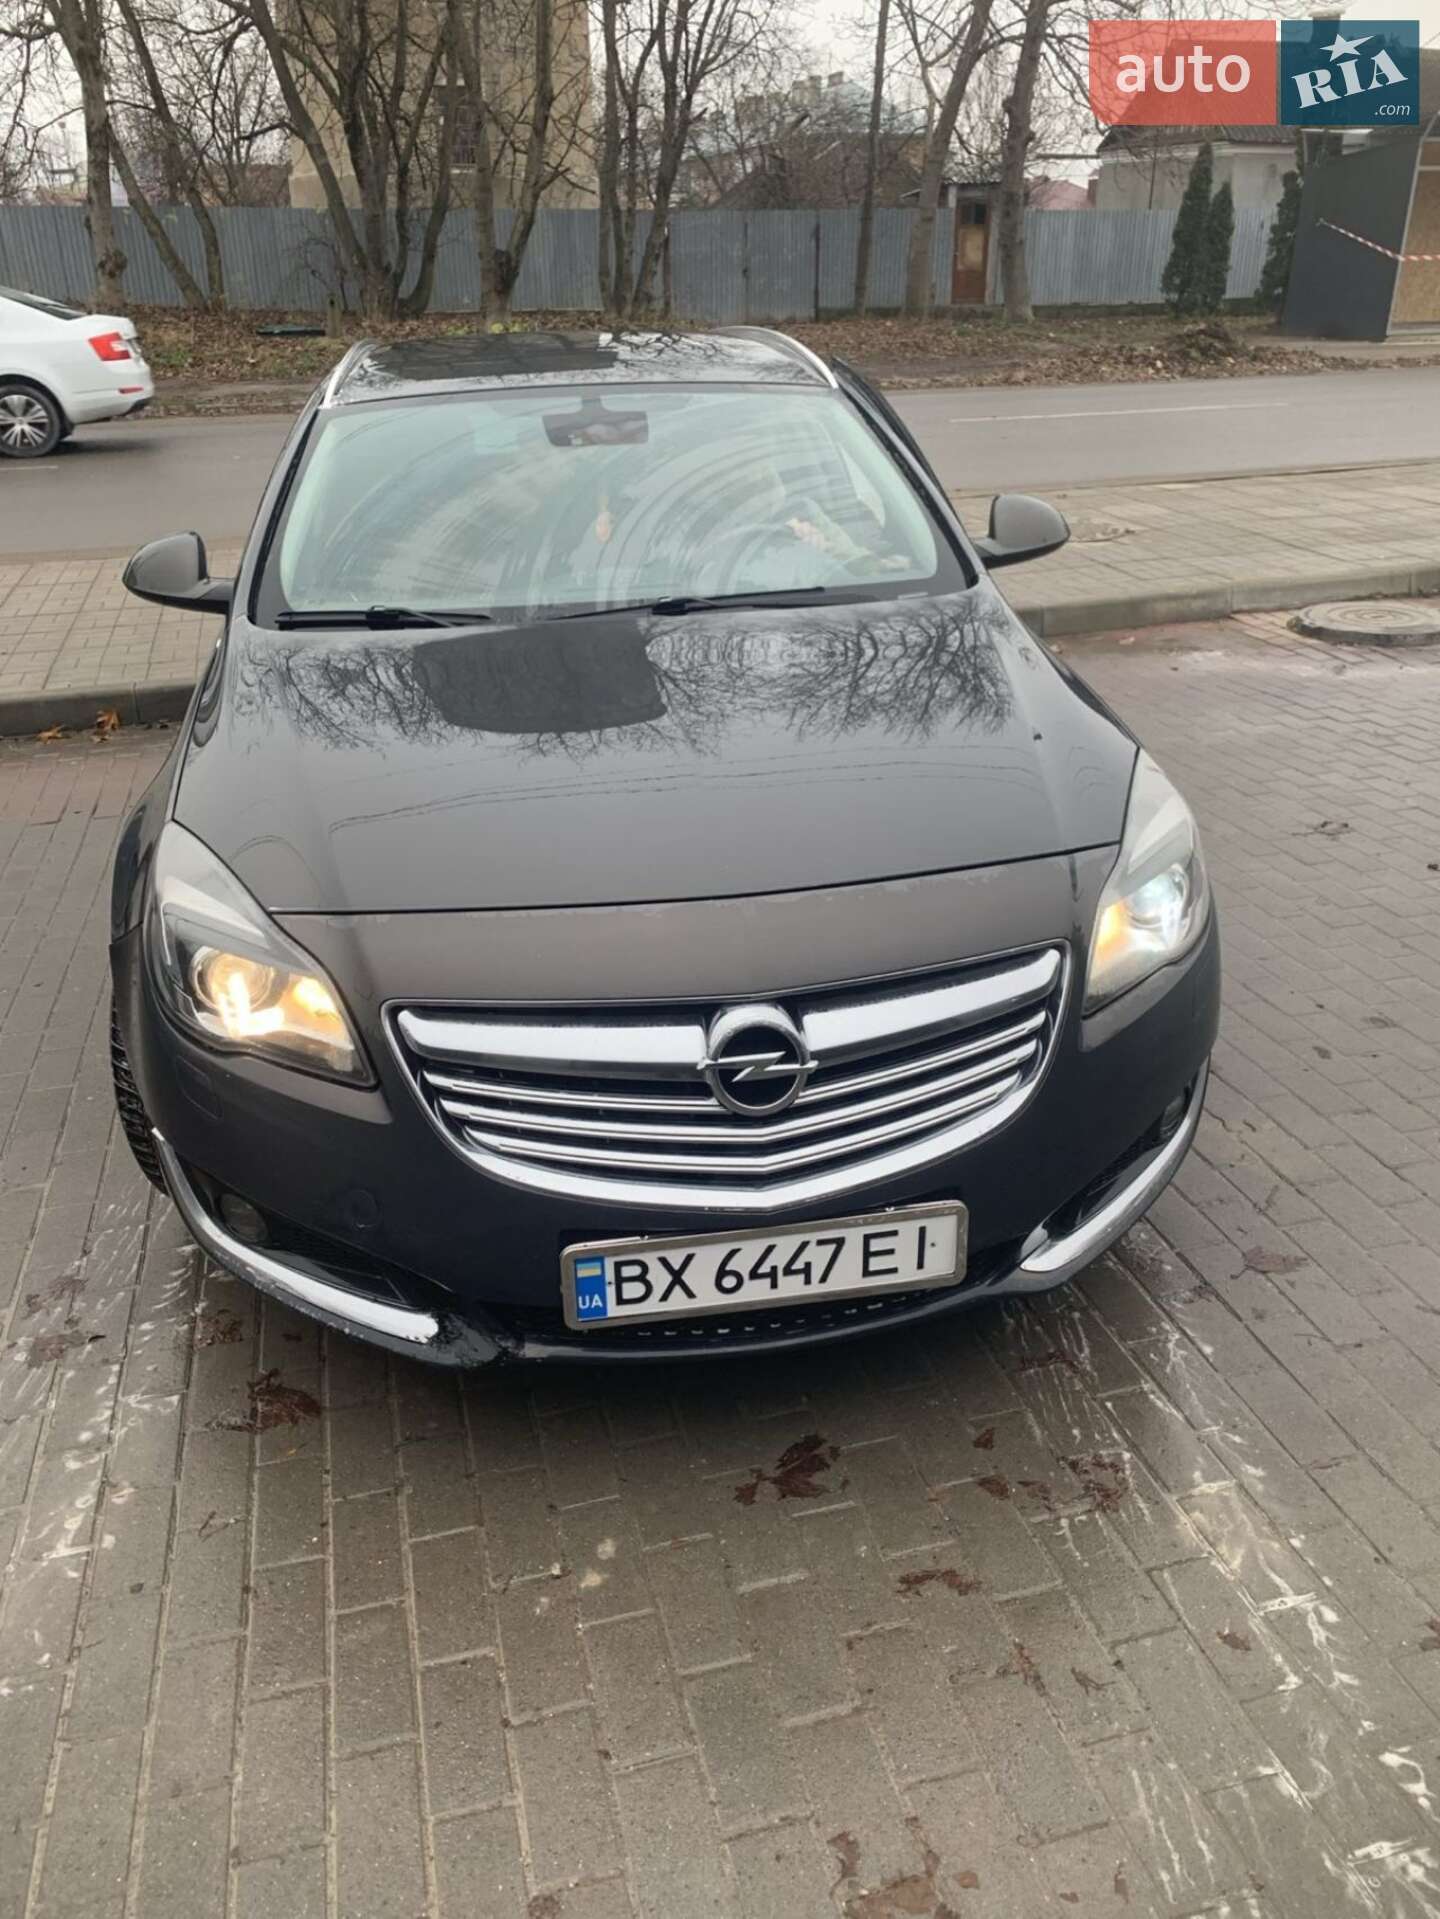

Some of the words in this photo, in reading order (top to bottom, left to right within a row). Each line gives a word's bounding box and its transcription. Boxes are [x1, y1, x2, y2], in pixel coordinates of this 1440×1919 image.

[613, 1253, 697, 1306] BX
[714, 1236, 845, 1295] 6447
[861, 1226, 927, 1279] EI
[578, 1295, 603, 1310] UA
